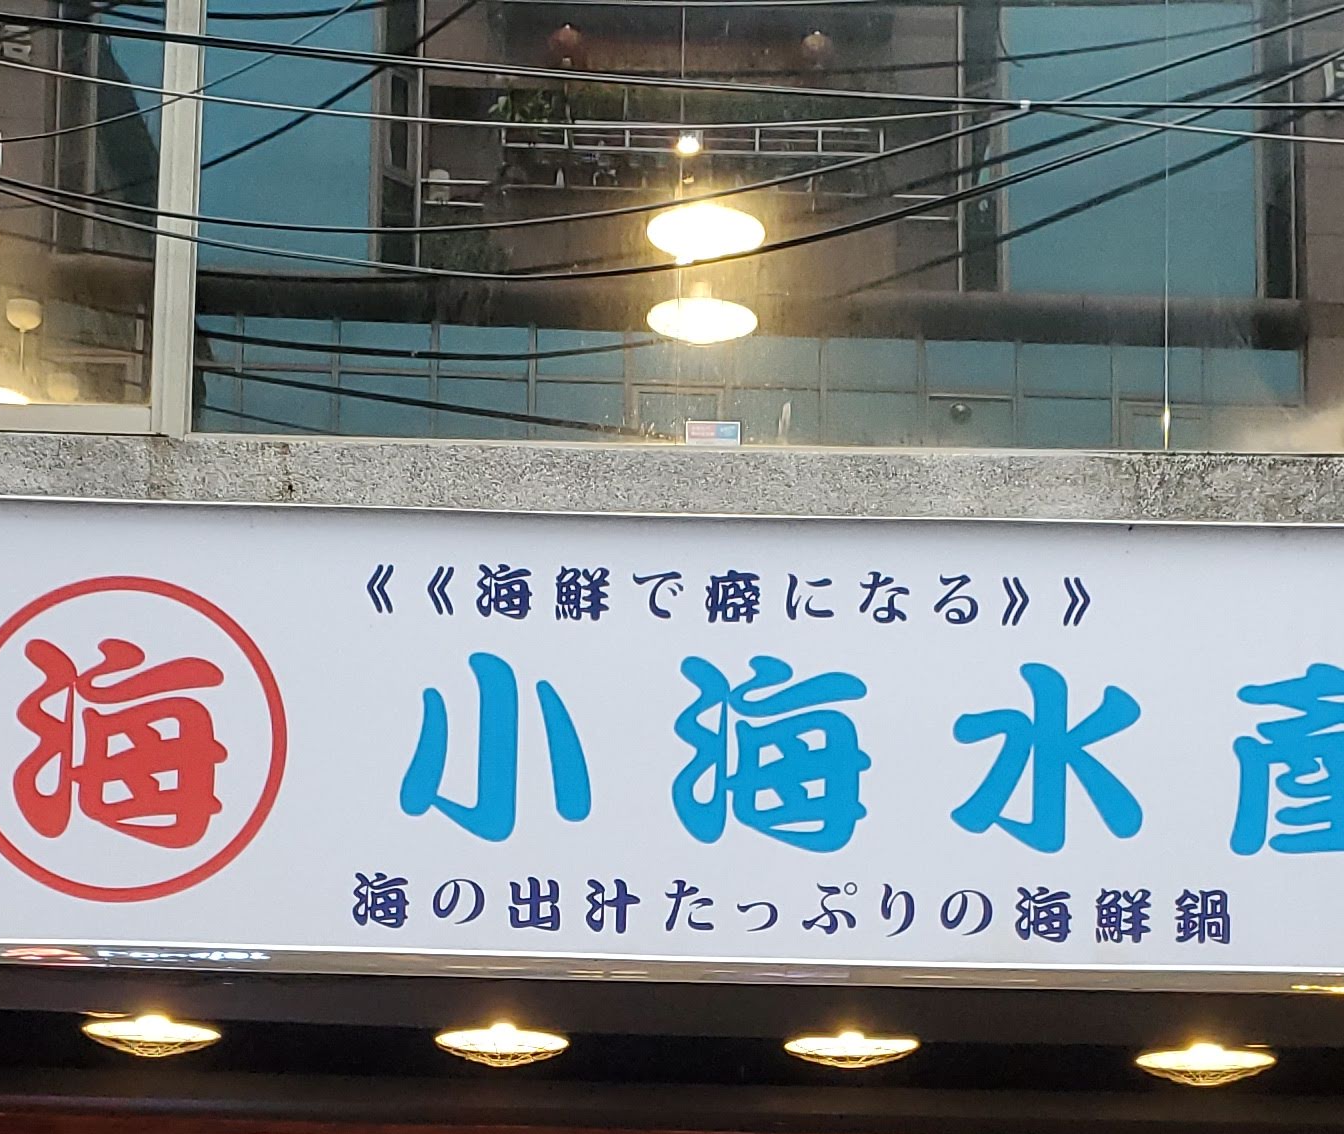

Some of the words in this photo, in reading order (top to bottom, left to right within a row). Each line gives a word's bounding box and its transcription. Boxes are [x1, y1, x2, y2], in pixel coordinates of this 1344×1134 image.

[14, 638, 227, 849] 海
[353, 872, 1231, 945] 海の出汁たっぷりの海鮮鍋
